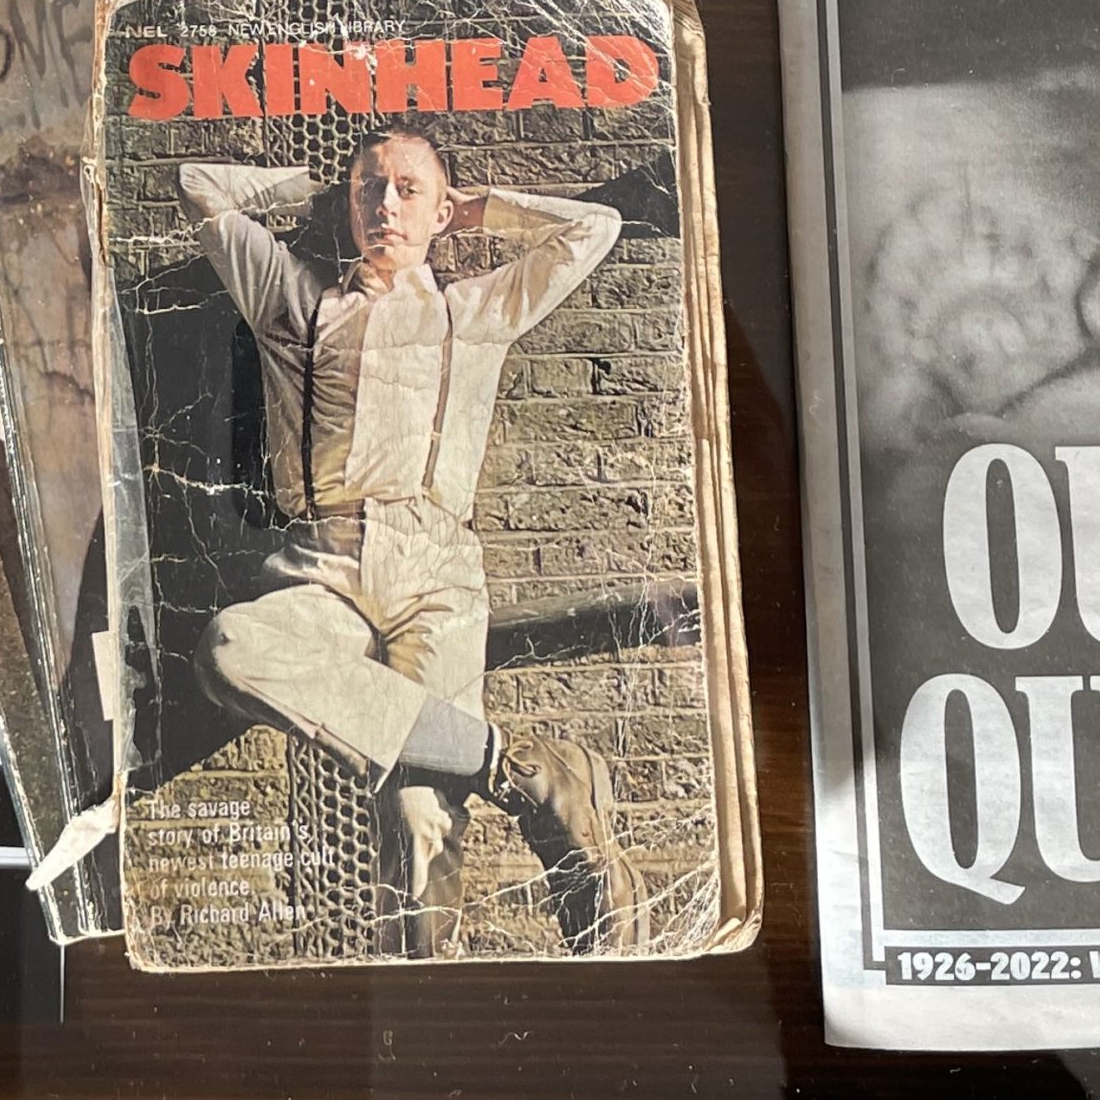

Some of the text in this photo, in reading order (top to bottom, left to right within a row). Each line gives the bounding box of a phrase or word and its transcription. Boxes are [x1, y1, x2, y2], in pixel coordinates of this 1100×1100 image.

[125, 25, 168, 39] NEL
[228, 21, 264, 37] NEW
[267, 20, 336, 37] ENGLISH
[128, 34, 661, 122] SKINHEAD
[149, 800, 250, 820] The savage
[149, 828, 193, 849] story
[202, 823, 221, 844] of
[149, 845, 335, 873] newest teenage cult
[149, 879, 168, 900] of
[150, 901, 306, 930] By Richard Allen
[897, 950, 1082, 981] 1926-2022:
